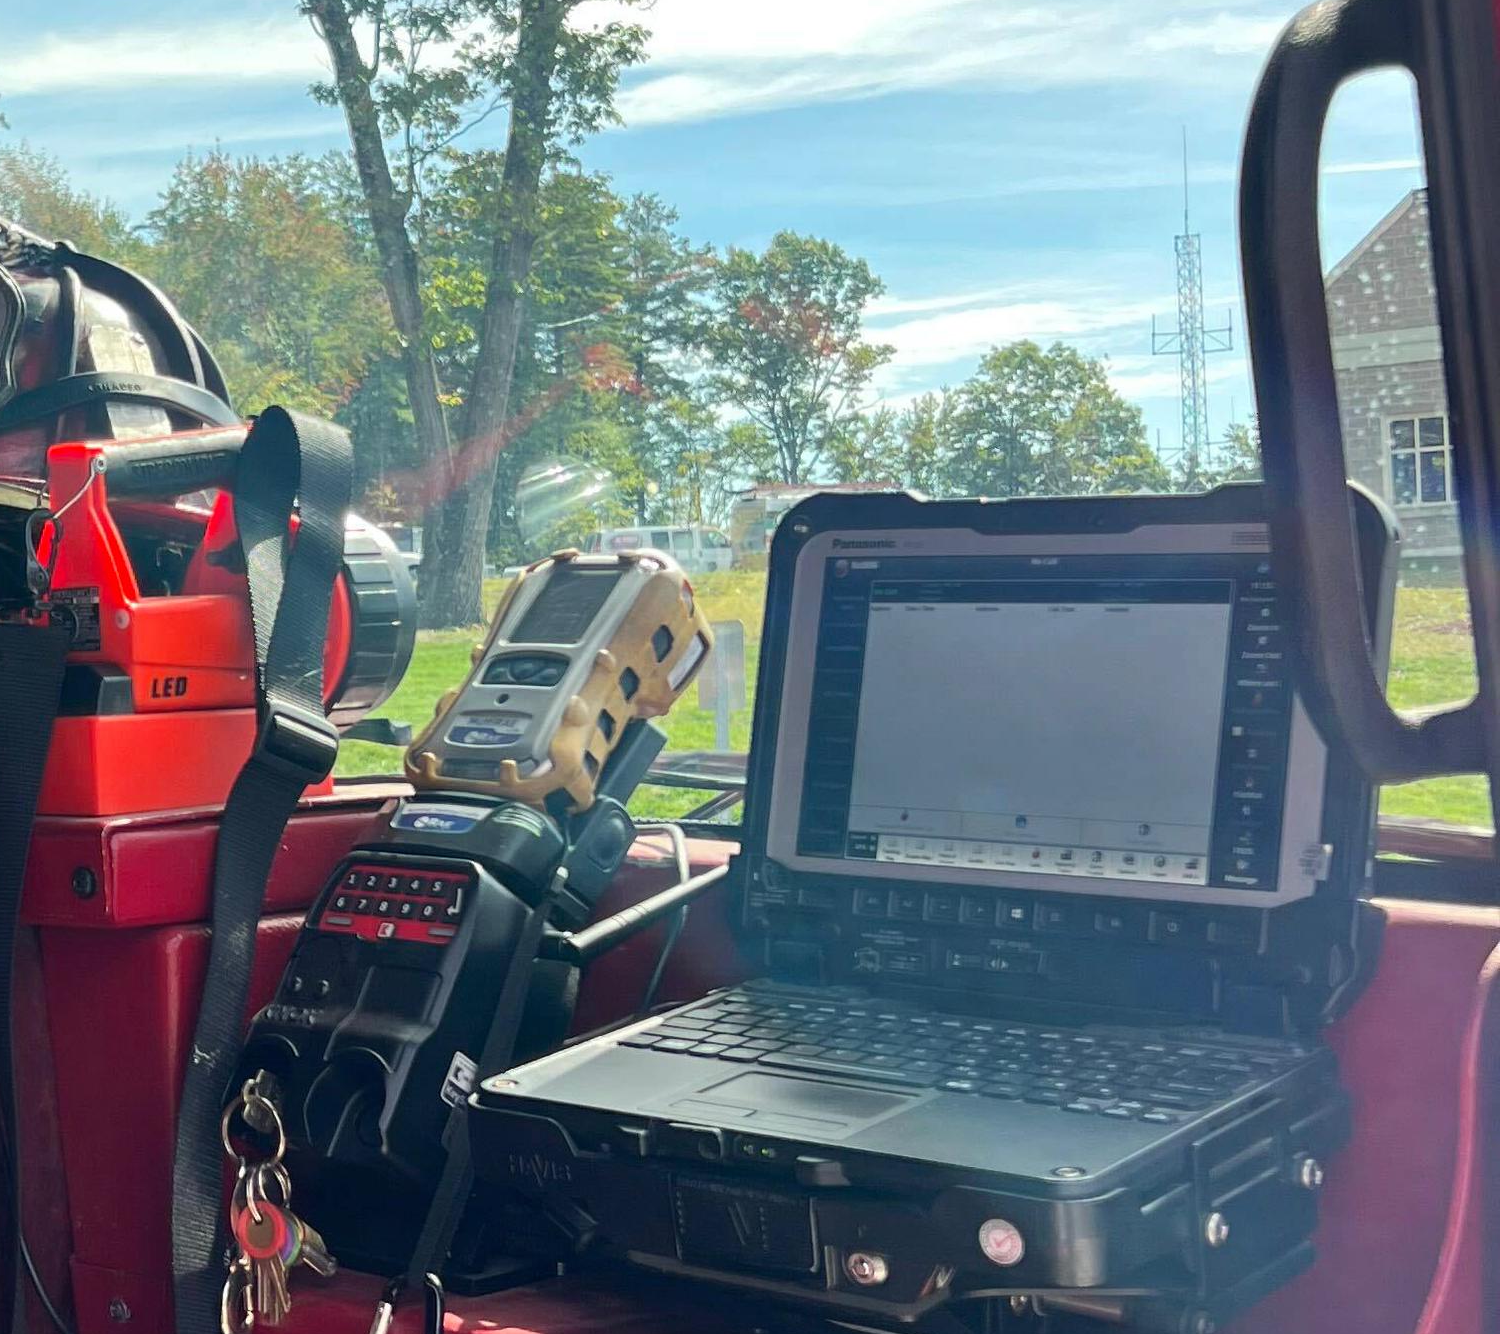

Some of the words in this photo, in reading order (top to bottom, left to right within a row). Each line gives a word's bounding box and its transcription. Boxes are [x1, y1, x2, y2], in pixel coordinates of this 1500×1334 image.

[832, 538, 897, 550] Panasonic
[151, 676, 188, 699] LED
[347, 873, 357, 885] 1
[366, 875, 377, 887] 2
[387, 877, 397, 889] 3
[410, 879, 420, 890] 4
[432, 881, 443, 892] 5
[336, 896, 345, 908] 6
[357, 898, 368, 910] 7
[378, 900, 389, 912] 8
[400, 903, 411, 915] 9
[423, 905, 433, 916] 0
